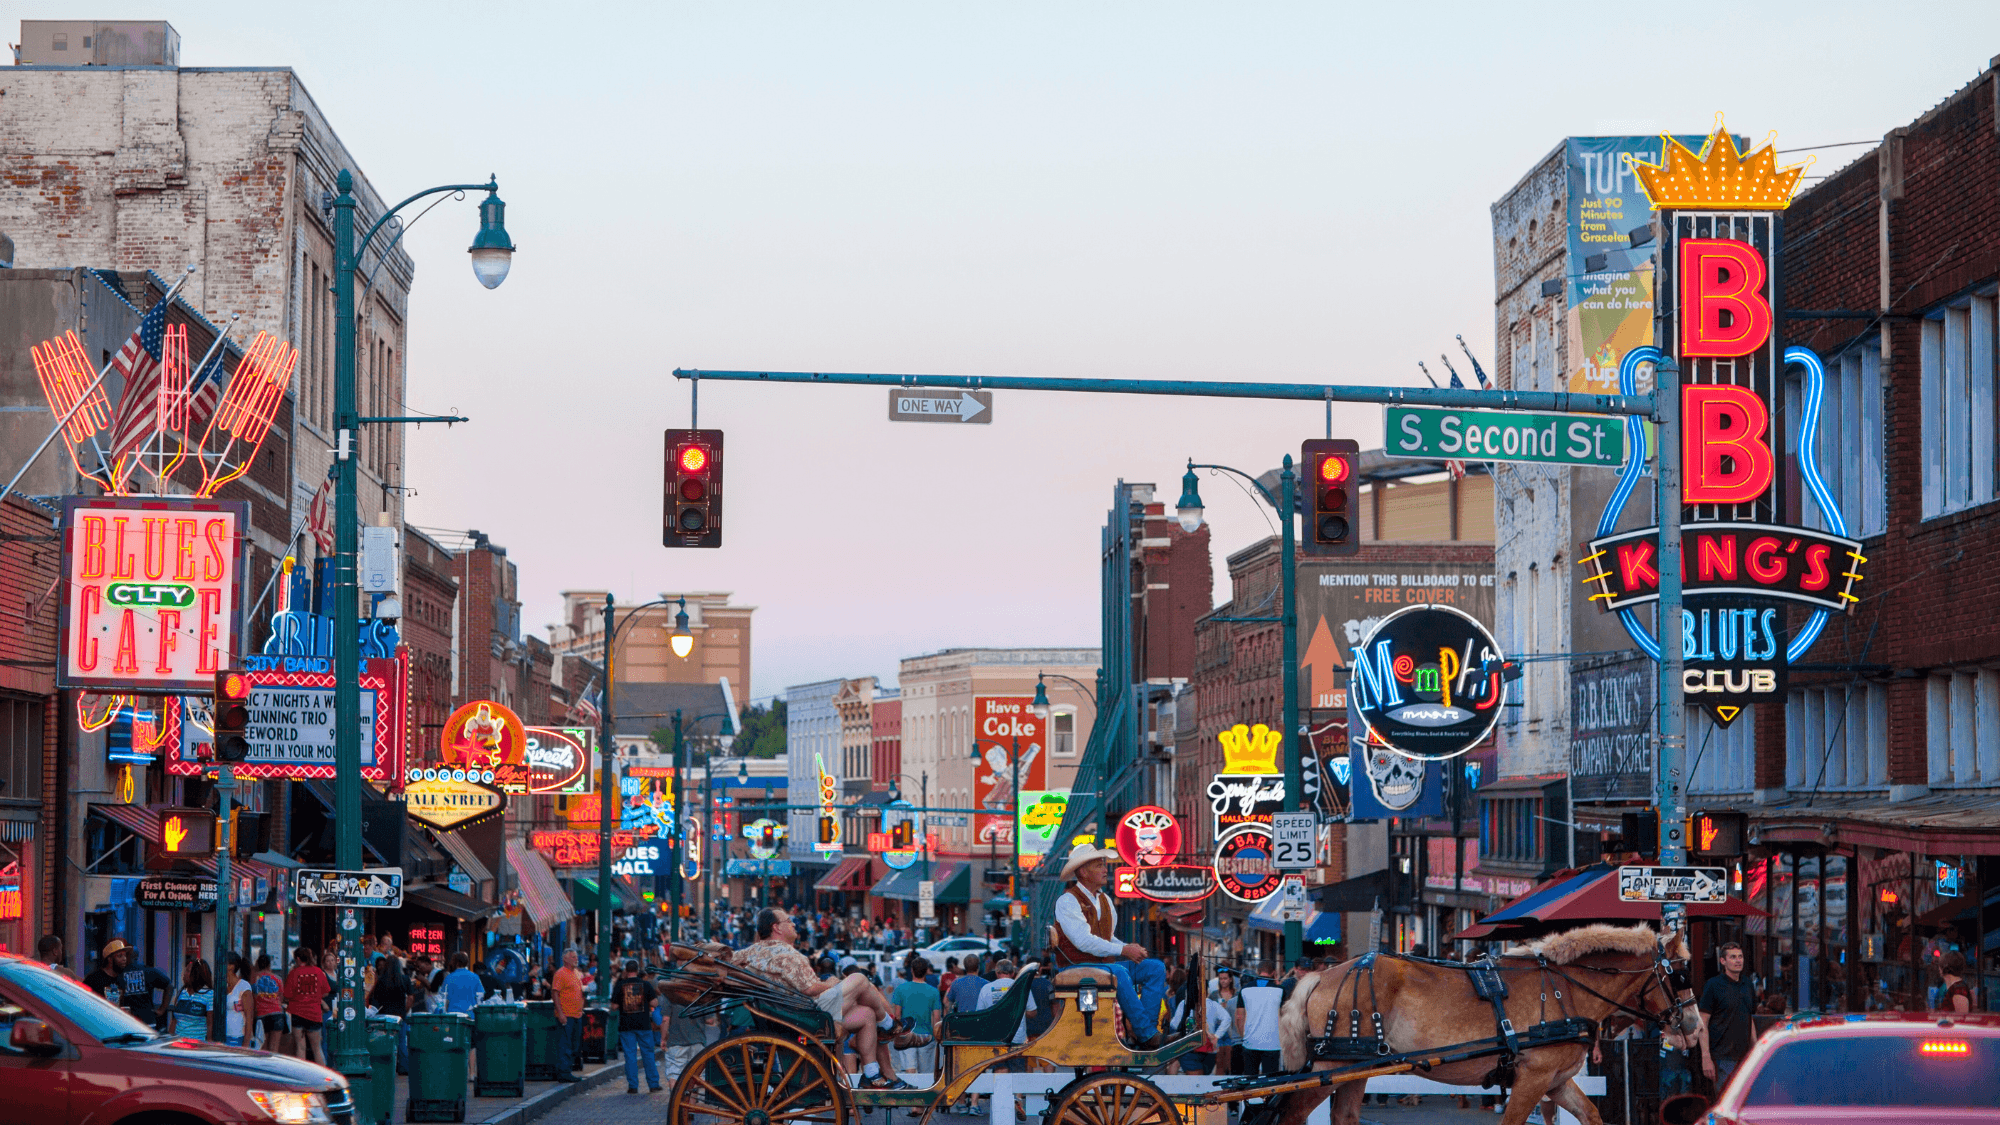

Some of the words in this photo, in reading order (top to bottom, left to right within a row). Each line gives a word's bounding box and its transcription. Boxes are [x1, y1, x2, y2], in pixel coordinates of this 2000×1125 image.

[1580, 152, 1656, 194] TUPE
[1580, 197, 1602, 209] Just
[1605, 197, 1622, 209] 90
[1580, 209, 1624, 220] Minutes
[1580, 220, 1606, 232] from
[1580, 231, 1631, 243] Gracelan
[1582, 271, 1630, 283] imagine
[1583, 284, 1612, 295] what
[1615, 285, 1636, 297] you
[1583, 299, 1600, 309] can
[1602, 298, 1622, 309] do
[1625, 298, 1653, 309] here
[1680, 238, 1773, 358] B
[1582, 357, 1653, 389] tupo
[902, 399, 929, 412] ONE
[934, 400, 963, 413] WAY
[1399, 414, 1429, 452] S.
[1438, 415, 1557, 457] Second
[1566, 421, 1612, 460] St.
[1682, 384, 1774, 504] B
[81, 516, 226, 582] BLUES
[1617, 534, 1832, 592] KNG'S
[1319, 574, 1369, 586] MENTION
[1372, 574, 1398, 586] THIS
[1401, 574, 1459, 586] BILLBOARD
[1462, 574, 1476, 586] TO
[113, 585, 190, 603] CITY
[1365, 588, 1401, 603] FREE
[1405, 588, 1455, 603] COVER
[78, 585, 222, 674] CAFE
[1682, 608, 1776, 660] BLUES
[246, 655, 280, 671] CITY
[284, 657, 330, 673] BAND
[1350, 639, 1500, 711] Memphis
[1682, 669, 1776, 694] CLUB
[263, 694, 269, 707] 7
[272, 694, 310, 708] NIGHTS
[313, 695, 320, 708] A
[986, 700, 1021, 714] Have
[1025, 704, 1034, 714] a
[247, 709, 297, 724] CUNNING
[301, 711, 327, 725] TRIO
[983, 716, 1036, 736] Coke
[275, 745, 284, 757] IN
[288, 745, 313, 758] YOUR
[1571, 736, 1614, 776] COMPANY
[1616, 732, 1650, 774] STORE
[444, 794, 494, 807] STREET
[1220, 815, 1244, 823] HALL
[1244, 815, 1257, 823] OF
[1276, 819, 1312, 828] SPEED
[1234, 833, 1267, 849] BAR
[1280, 831, 1308, 839] LIMIT
[555, 848, 601, 863] CAF
[1277, 842, 1312, 861] 25
[141, 881, 163, 891] First
[165, 882, 197, 892] Chance
[200, 883, 218, 891] RIBS
[1223, 877, 1241, 893] 159
[1244, 877, 1279, 899] BEALE
[144, 891, 158, 900] For
[159, 891, 166, 900] A
[168, 891, 193, 901] Drink
[411, 929, 443, 940] FROZEN
[411, 943, 441, 954] DRINKS
